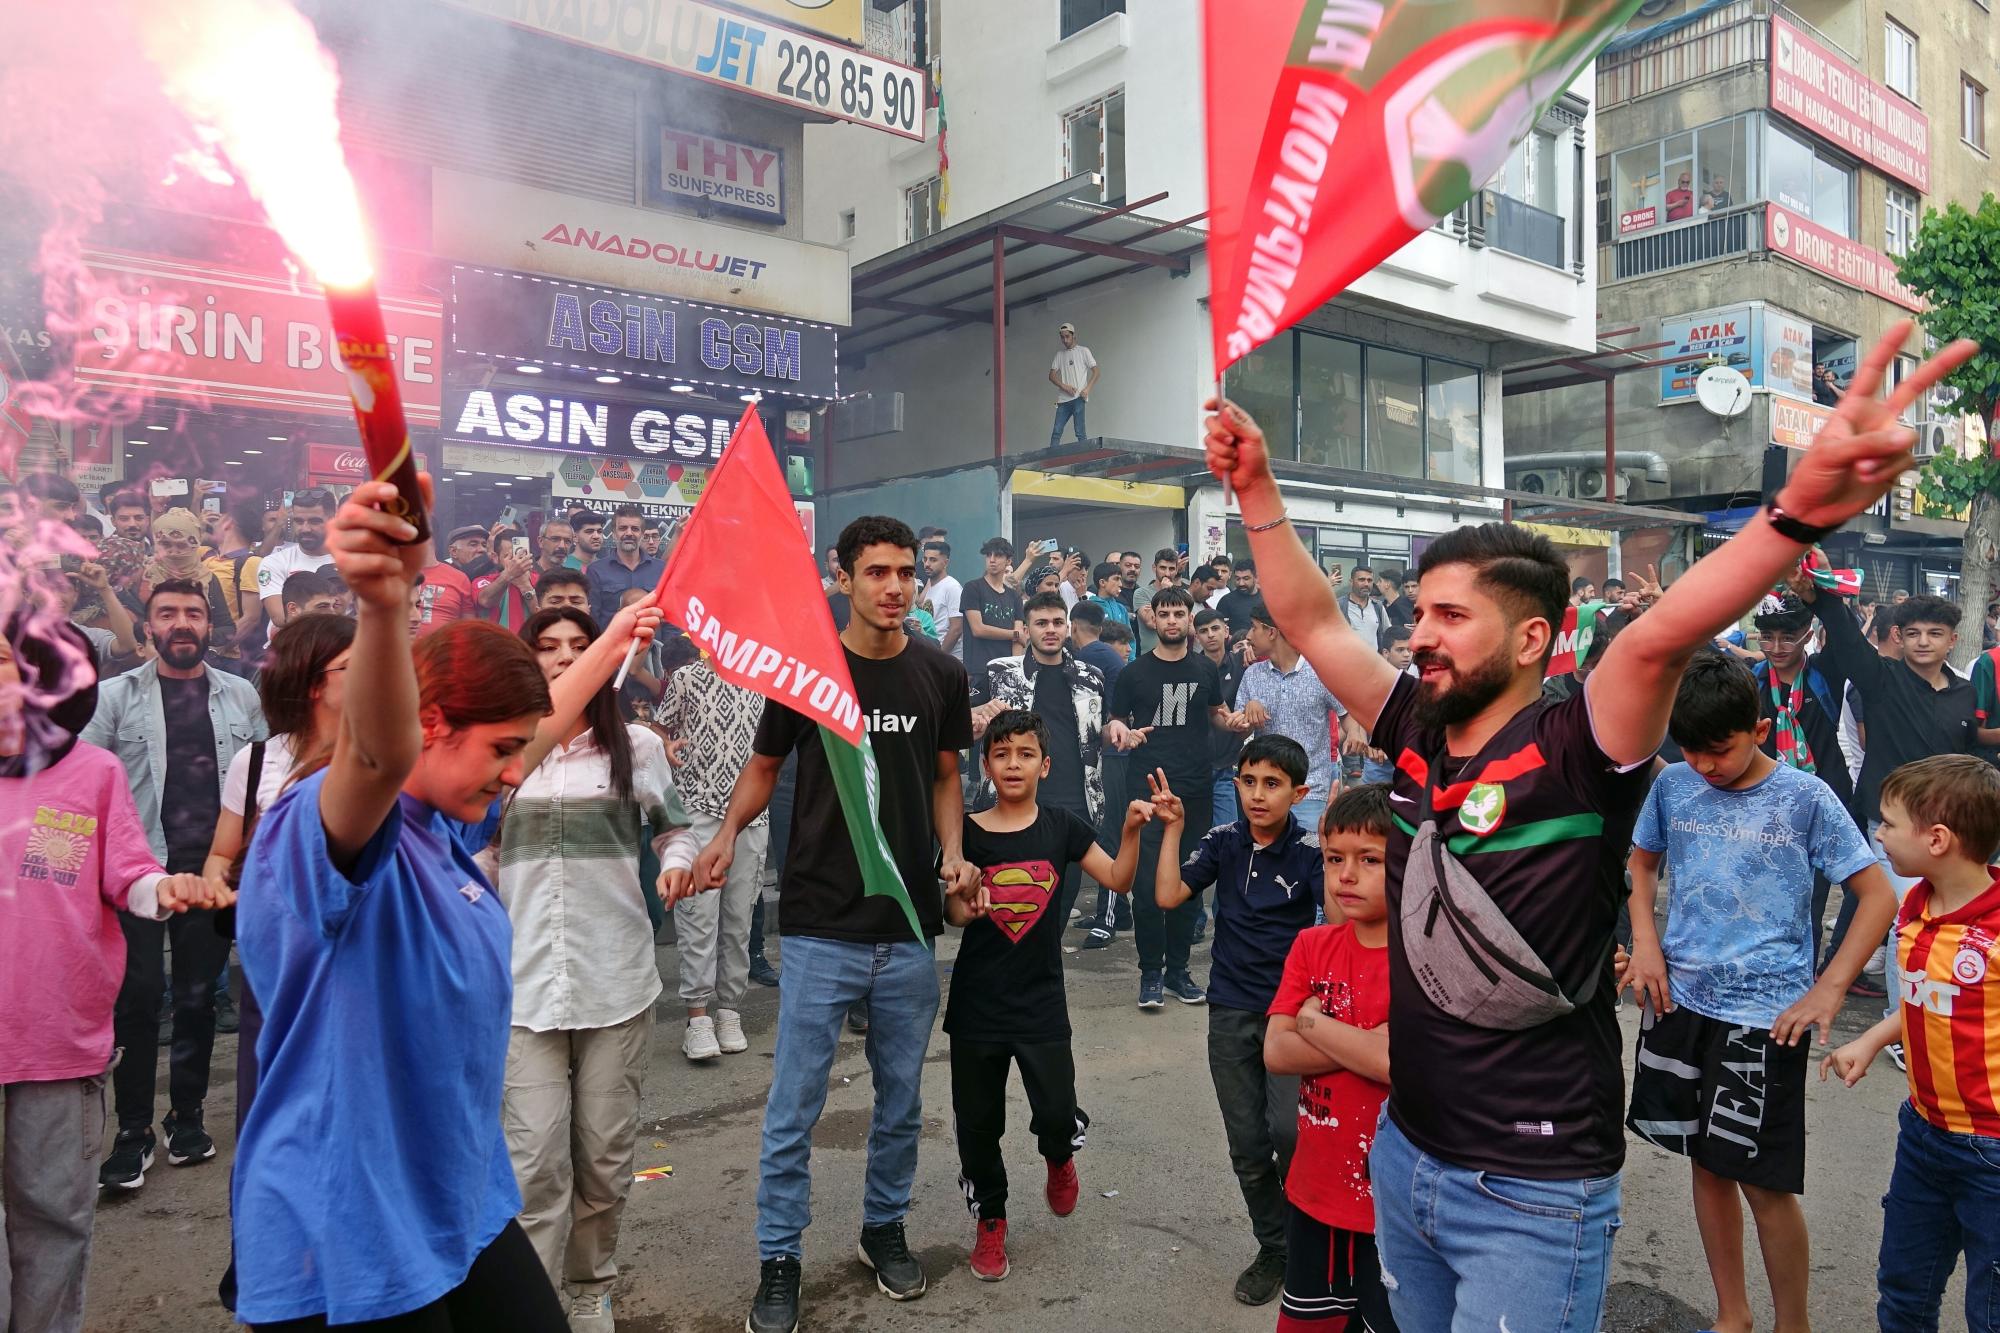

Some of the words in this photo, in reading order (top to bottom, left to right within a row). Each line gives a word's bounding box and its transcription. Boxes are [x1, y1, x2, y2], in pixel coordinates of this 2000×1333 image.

[777, 38, 831, 107] 228
[841, 58, 874, 119] 85
[883, 71, 916, 131] 90
[1776, 77, 1803, 113] BİLİM
[1805, 95, 1851, 140] HAVACILIK
[1851, 122, 1862, 148] VE
[1794, 41, 1825, 93] DRONE
[1827, 63, 1858, 113] YETKİLİ
[1887, 103, 1927, 155] KURULUŞU
[665, 130, 777, 188] THY
[667, 172, 777, 208] SUNEXPRESS
[1632, 210, 1655, 223] DRONE
[541, 223, 767, 280] ANADOLUJET
[1795, 227, 1835, 271] DRONE
[1837, 244, 1876, 289] EĞİTİM
[94, 286, 264, 364] ŞİRİN
[700, 317, 801, 381] GSM
[1688, 321, 1737, 343] ATAK
[1783, 326, 1804, 346] ATAK
[1776, 404, 1810, 433] ATAK
